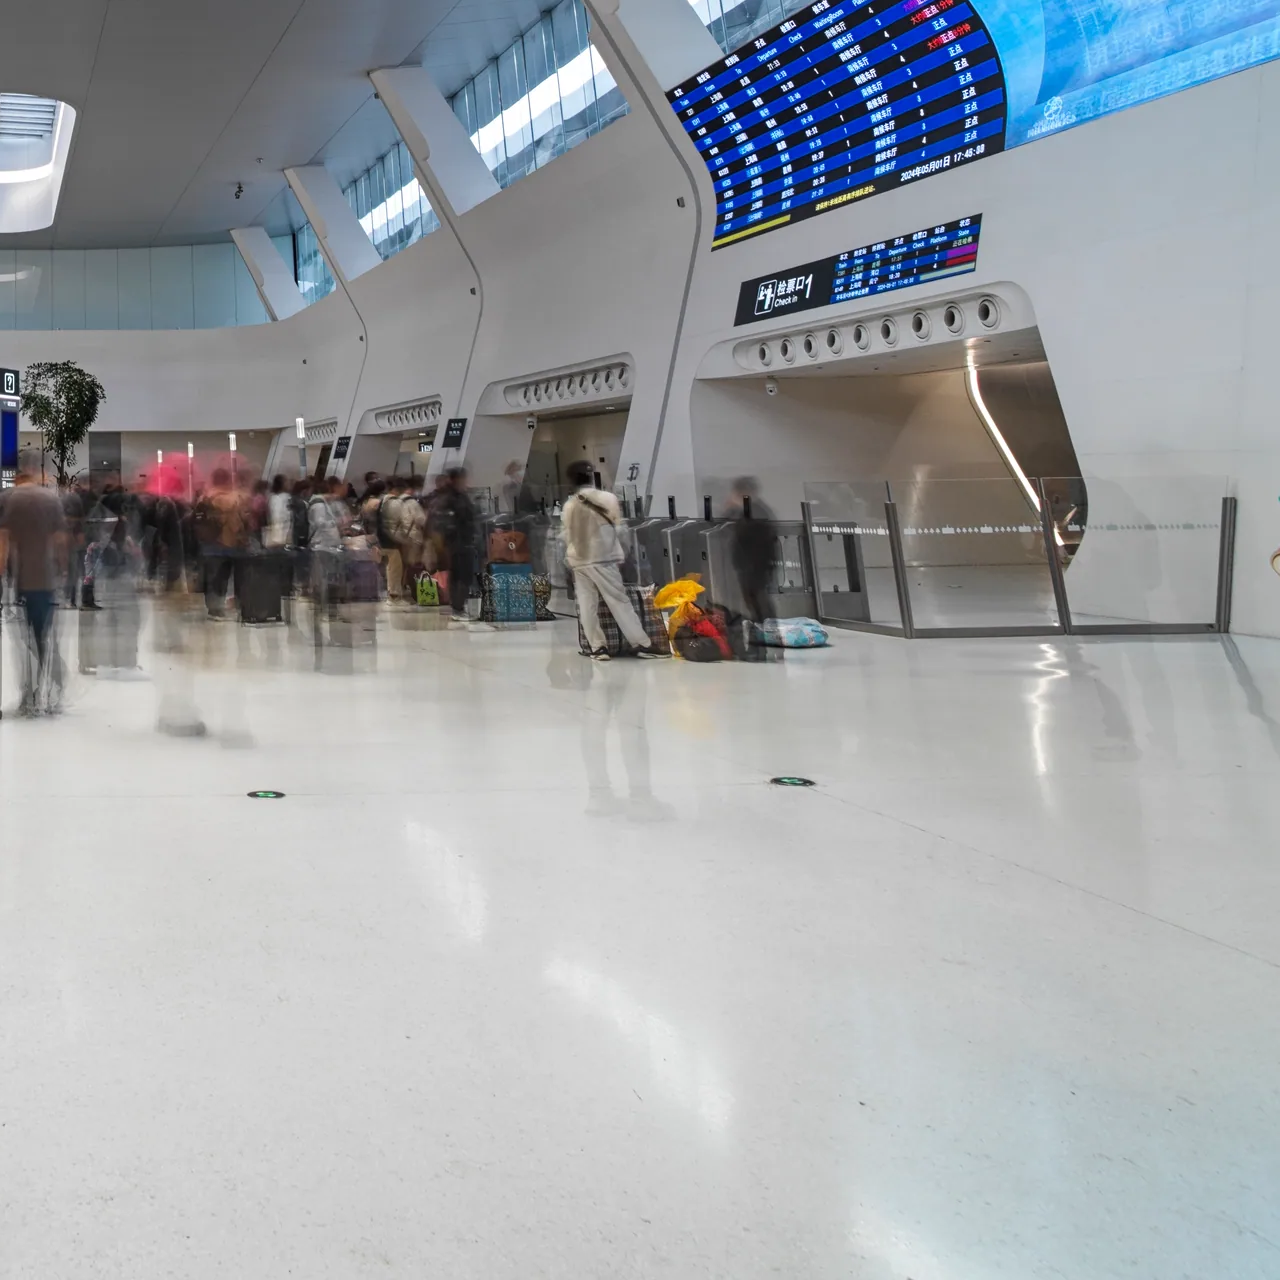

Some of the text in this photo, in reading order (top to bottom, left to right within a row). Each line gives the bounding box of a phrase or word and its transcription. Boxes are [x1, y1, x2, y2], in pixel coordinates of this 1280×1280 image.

[875, 18, 882, 26] 3
[931, 17, 948, 30] 正点
[757, 48, 777, 62] Departure
[788, 32, 802, 43] Check
[813, 9, 844, 28] WaitingRoom
[906, 68, 912, 76] 3
[947, 44, 963, 57] 正点
[953, 57, 969, 71] 正点
[958, 72, 973, 85] 正点
[962, 86, 976, 100] 正点
[964, 101, 978, 114] 正点
[964, 115, 978, 128] 正点
[964, 130, 977, 143] 正点
[912, 241, 924, 249] Check
[930, 236, 947, 244] Platform
[958, 229, 969, 237] State
[777, 274, 813, 299] 检票口 1
[774, 296, 791, 307] Check
